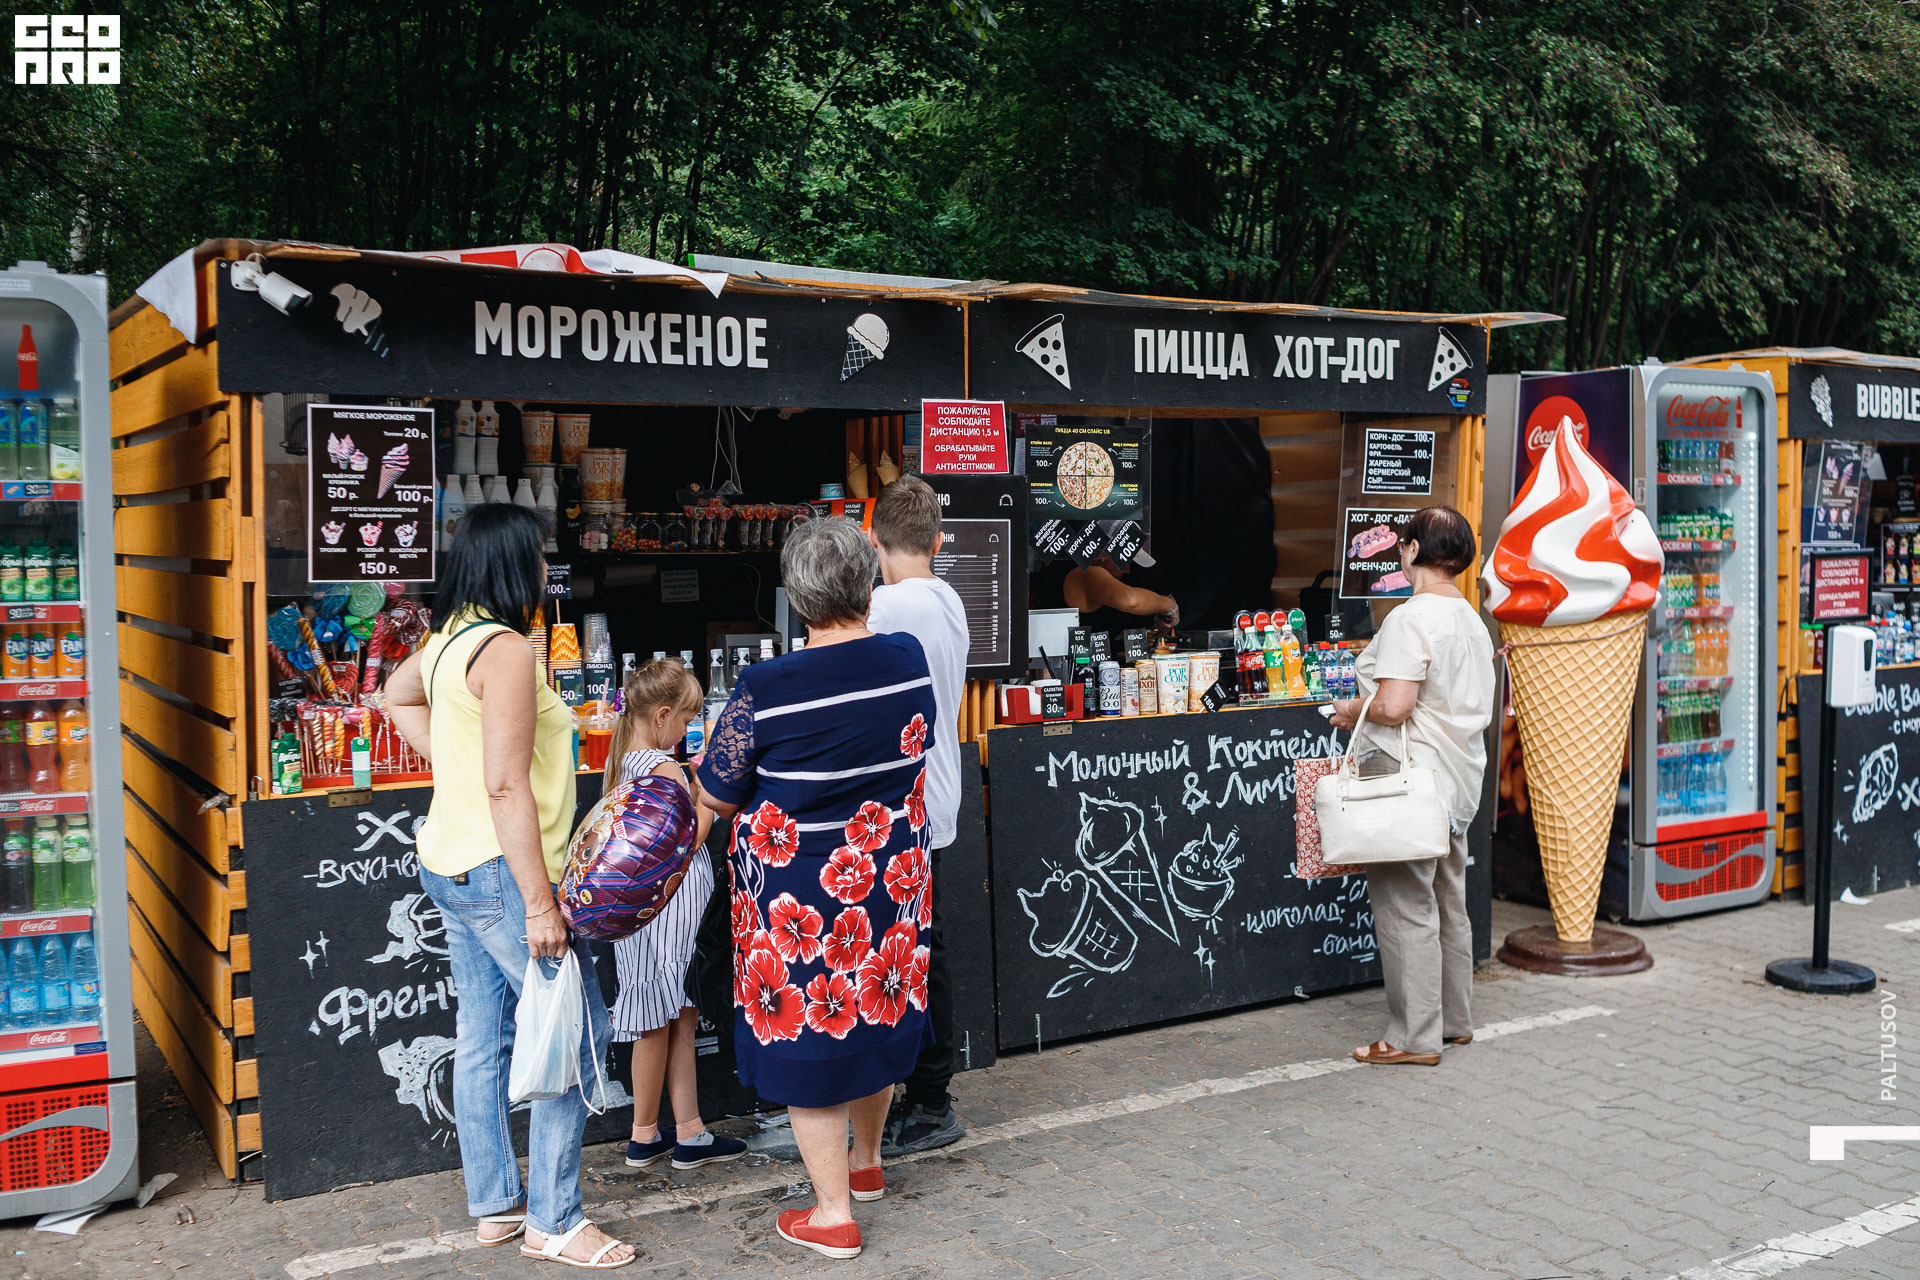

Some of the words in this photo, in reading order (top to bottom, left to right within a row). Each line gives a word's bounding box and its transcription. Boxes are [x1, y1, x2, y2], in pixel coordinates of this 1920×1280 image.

[474, 300, 769, 369] МОРОЖЕНОЕ
[1134, 328, 1250, 381] ПИЦЦА
[1273, 335, 1400, 384] ХОТ-ДОГ
[1856, 383, 1920, 422] BUBBLE
[937, 405, 991, 416] ПОЖАЛУЙСТА!
[333, 411, 365, 420] МЯГКОЕ
[365, 411, 416, 422] МОРОЖЕНОЕ
[938, 416, 991, 427] СОБЛЮДАЙТЕ
[404, 427, 420, 438] 20
[929, 427, 980, 437] ДИСТАНЦИЮ
[981, 428, 992, 437] 1,5
[1087, 427, 1103, 435] СЛАЙС
[1369, 432, 1387, 441] КОРН
[934, 444, 996, 453] ОБРАБАТЫВАЙТЕ
[1369, 443, 1403, 451] КАРТОФЕЛЬ
[958, 453, 977, 462] РУКИ
[1413, 449, 1432, 459] 100.-
[935, 462, 996, 471] АНТИСЕПТИКОМ!
[1036, 459, 1053, 467] 100.-
[1121, 461, 1136, 469] 100.-
[1368, 458, 1402, 468] ЖАРЕНЫЙ
[1368, 467, 1411, 476] ФЕРМЕРСКИЙ
[1411, 476, 1430, 485] 100.-
[1667, 473, 1702, 484] ОСВЕЖИС
[327, 487, 347, 499] 50
[395, 490, 421, 502] 100
[1034, 497, 1052, 505] 100.-
[1123, 498, 1138, 506] 100.-
[1351, 513, 1368, 523] ХОТ
[1374, 513, 1393, 524] ДОГ
[1046, 530, 1057, 543] СЫР
[1106, 519, 1133, 553] КАРТОФЕЛЬ
[1050, 533, 1070, 555] 100.-
[1081, 536, 1102, 559] 100.-
[1119, 537, 1141, 562] 100.-
[358, 562, 387, 575] 150
[1349, 562, 1399, 571] ФРЕНЧ-ДОГ
[546, 583, 571, 594] 100.-
[1090, 634, 1107, 642] ПИВО
[1127, 633, 1143, 641] КВАС
[1091, 653, 1111, 662] 100.-
[1127, 649, 1147, 658] 100.-
[555, 668, 582, 676] ЛИМОНАД
[1168, 667, 1187, 676] POP
[1201, 666, 1218, 675] POP
[561, 690, 582, 701] 50.-
[1046, 703, 1064, 714] 30.-
[1182, 771, 1211, 815] &
[1216, 765, 1296, 809] Лимо
